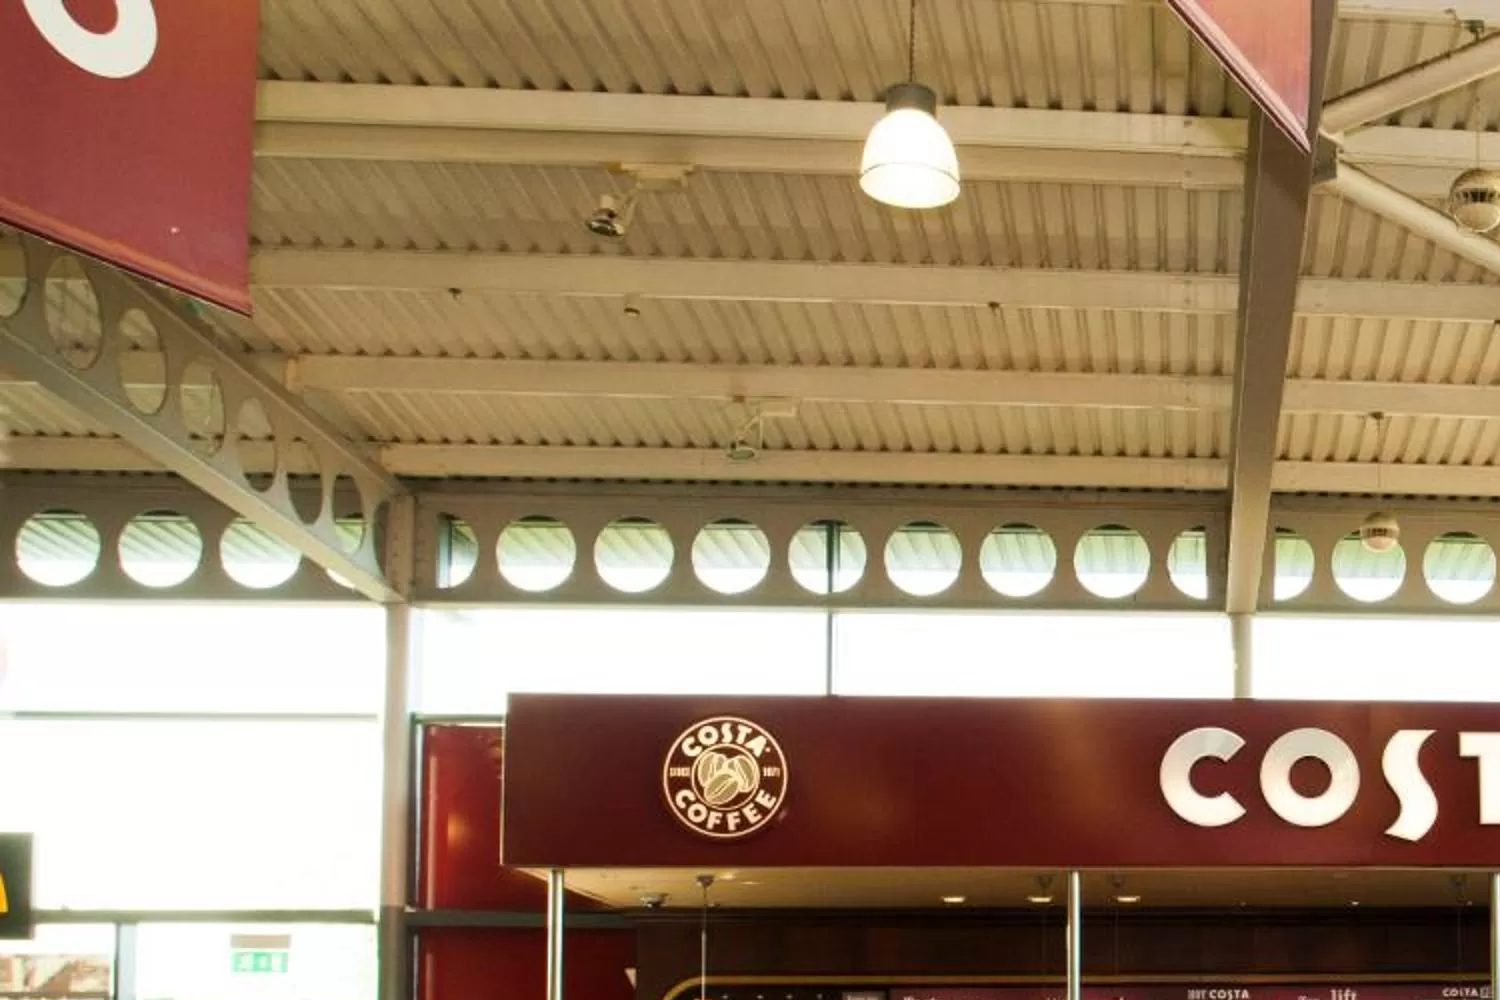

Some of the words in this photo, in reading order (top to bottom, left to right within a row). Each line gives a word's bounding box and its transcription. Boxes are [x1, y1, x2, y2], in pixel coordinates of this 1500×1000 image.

[681, 723, 767, 757] COSTA
[675, 789, 777, 831] COFFEE
[1208, 989, 1249, 1000] COSTA
[1442, 987, 1479, 997] COSTA
